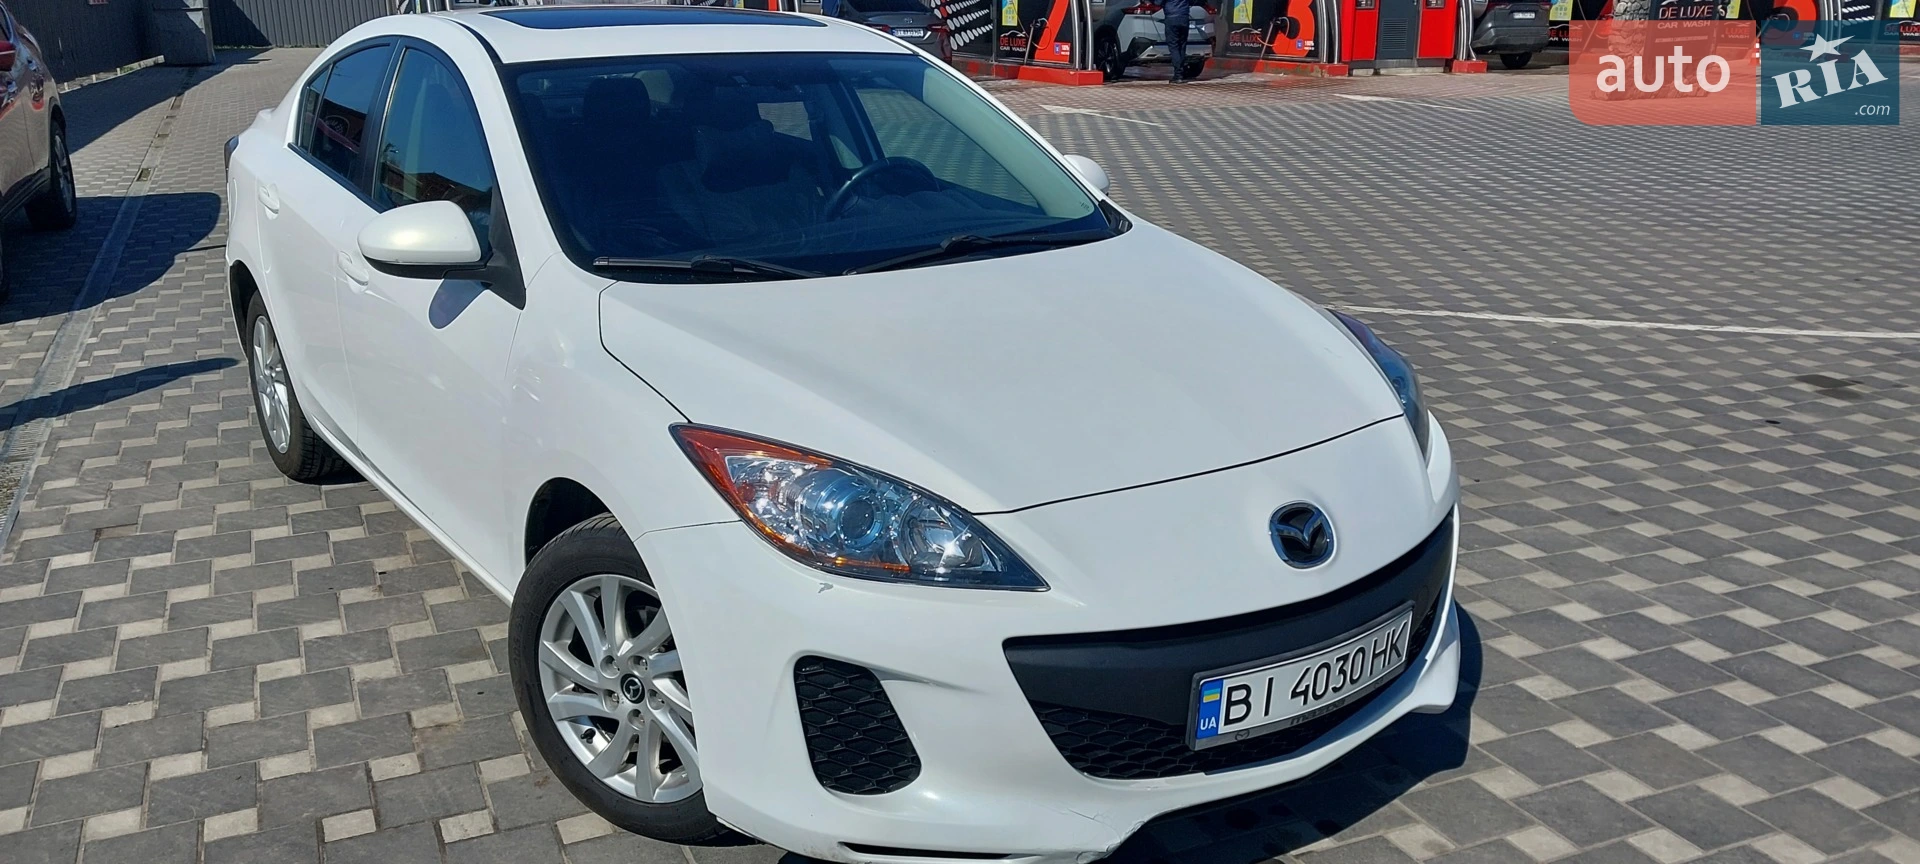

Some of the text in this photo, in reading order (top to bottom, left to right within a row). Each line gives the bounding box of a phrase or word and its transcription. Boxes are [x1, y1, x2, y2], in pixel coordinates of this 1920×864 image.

[1658, 5, 1714, 19] DE LUXE
[1682, 20, 1711, 28] WASH
[1000, 37, 1027, 47] DE LUXE
[1230, 34, 1262, 43] DE LUXE
[1289, 646, 1366, 706] 4030
[1368, 619, 1408, 677] HK
[1200, 717, 1217, 731] UA
